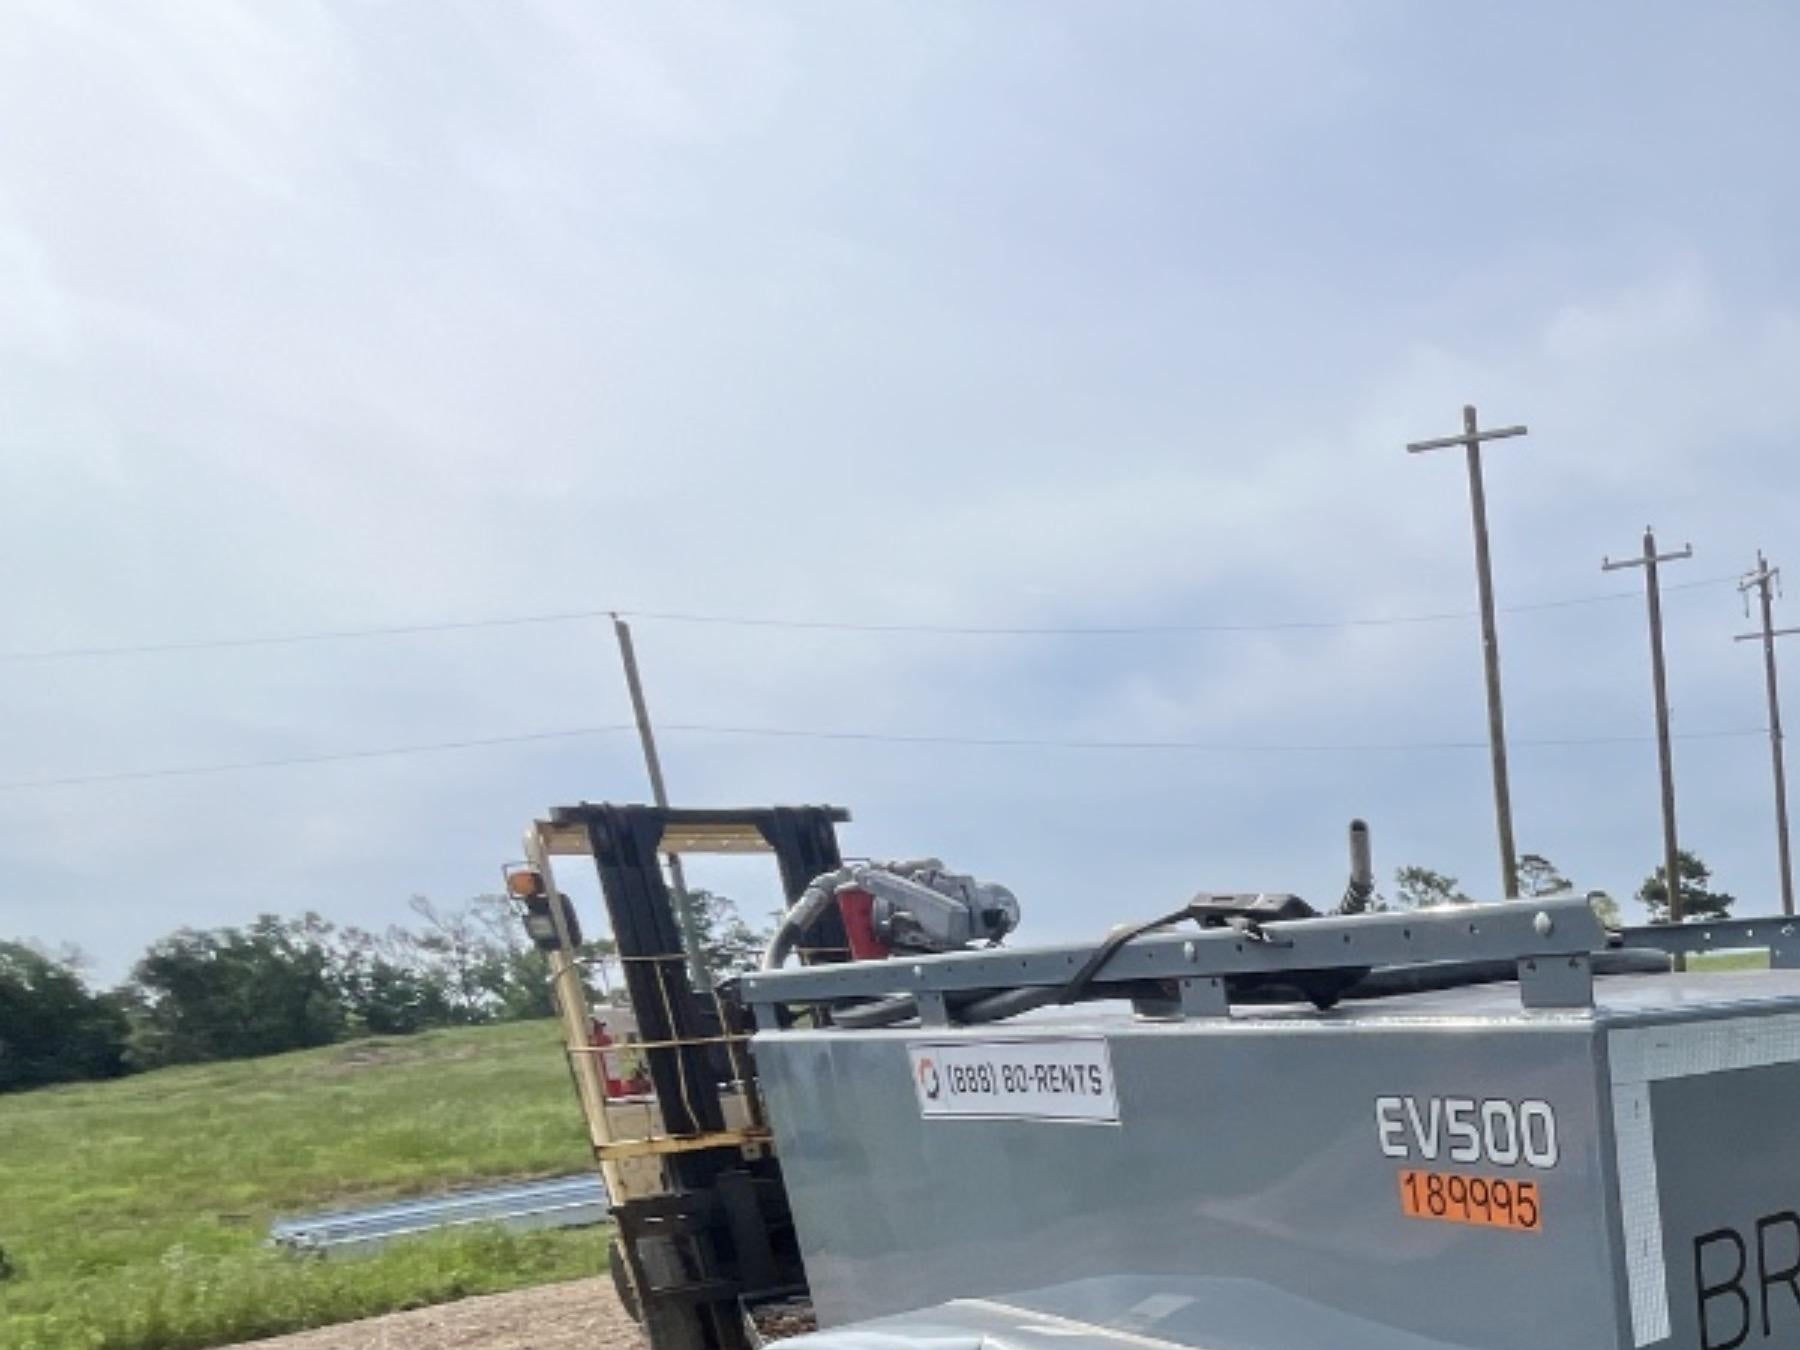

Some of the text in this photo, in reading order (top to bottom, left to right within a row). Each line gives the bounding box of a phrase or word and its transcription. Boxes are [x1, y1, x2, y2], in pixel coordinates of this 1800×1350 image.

[946, 1062, 1103, 1096] (888) 80-RENTS
[1375, 1096, 1560, 1169] EV500
[1404, 1172, 1538, 1228] 189995
